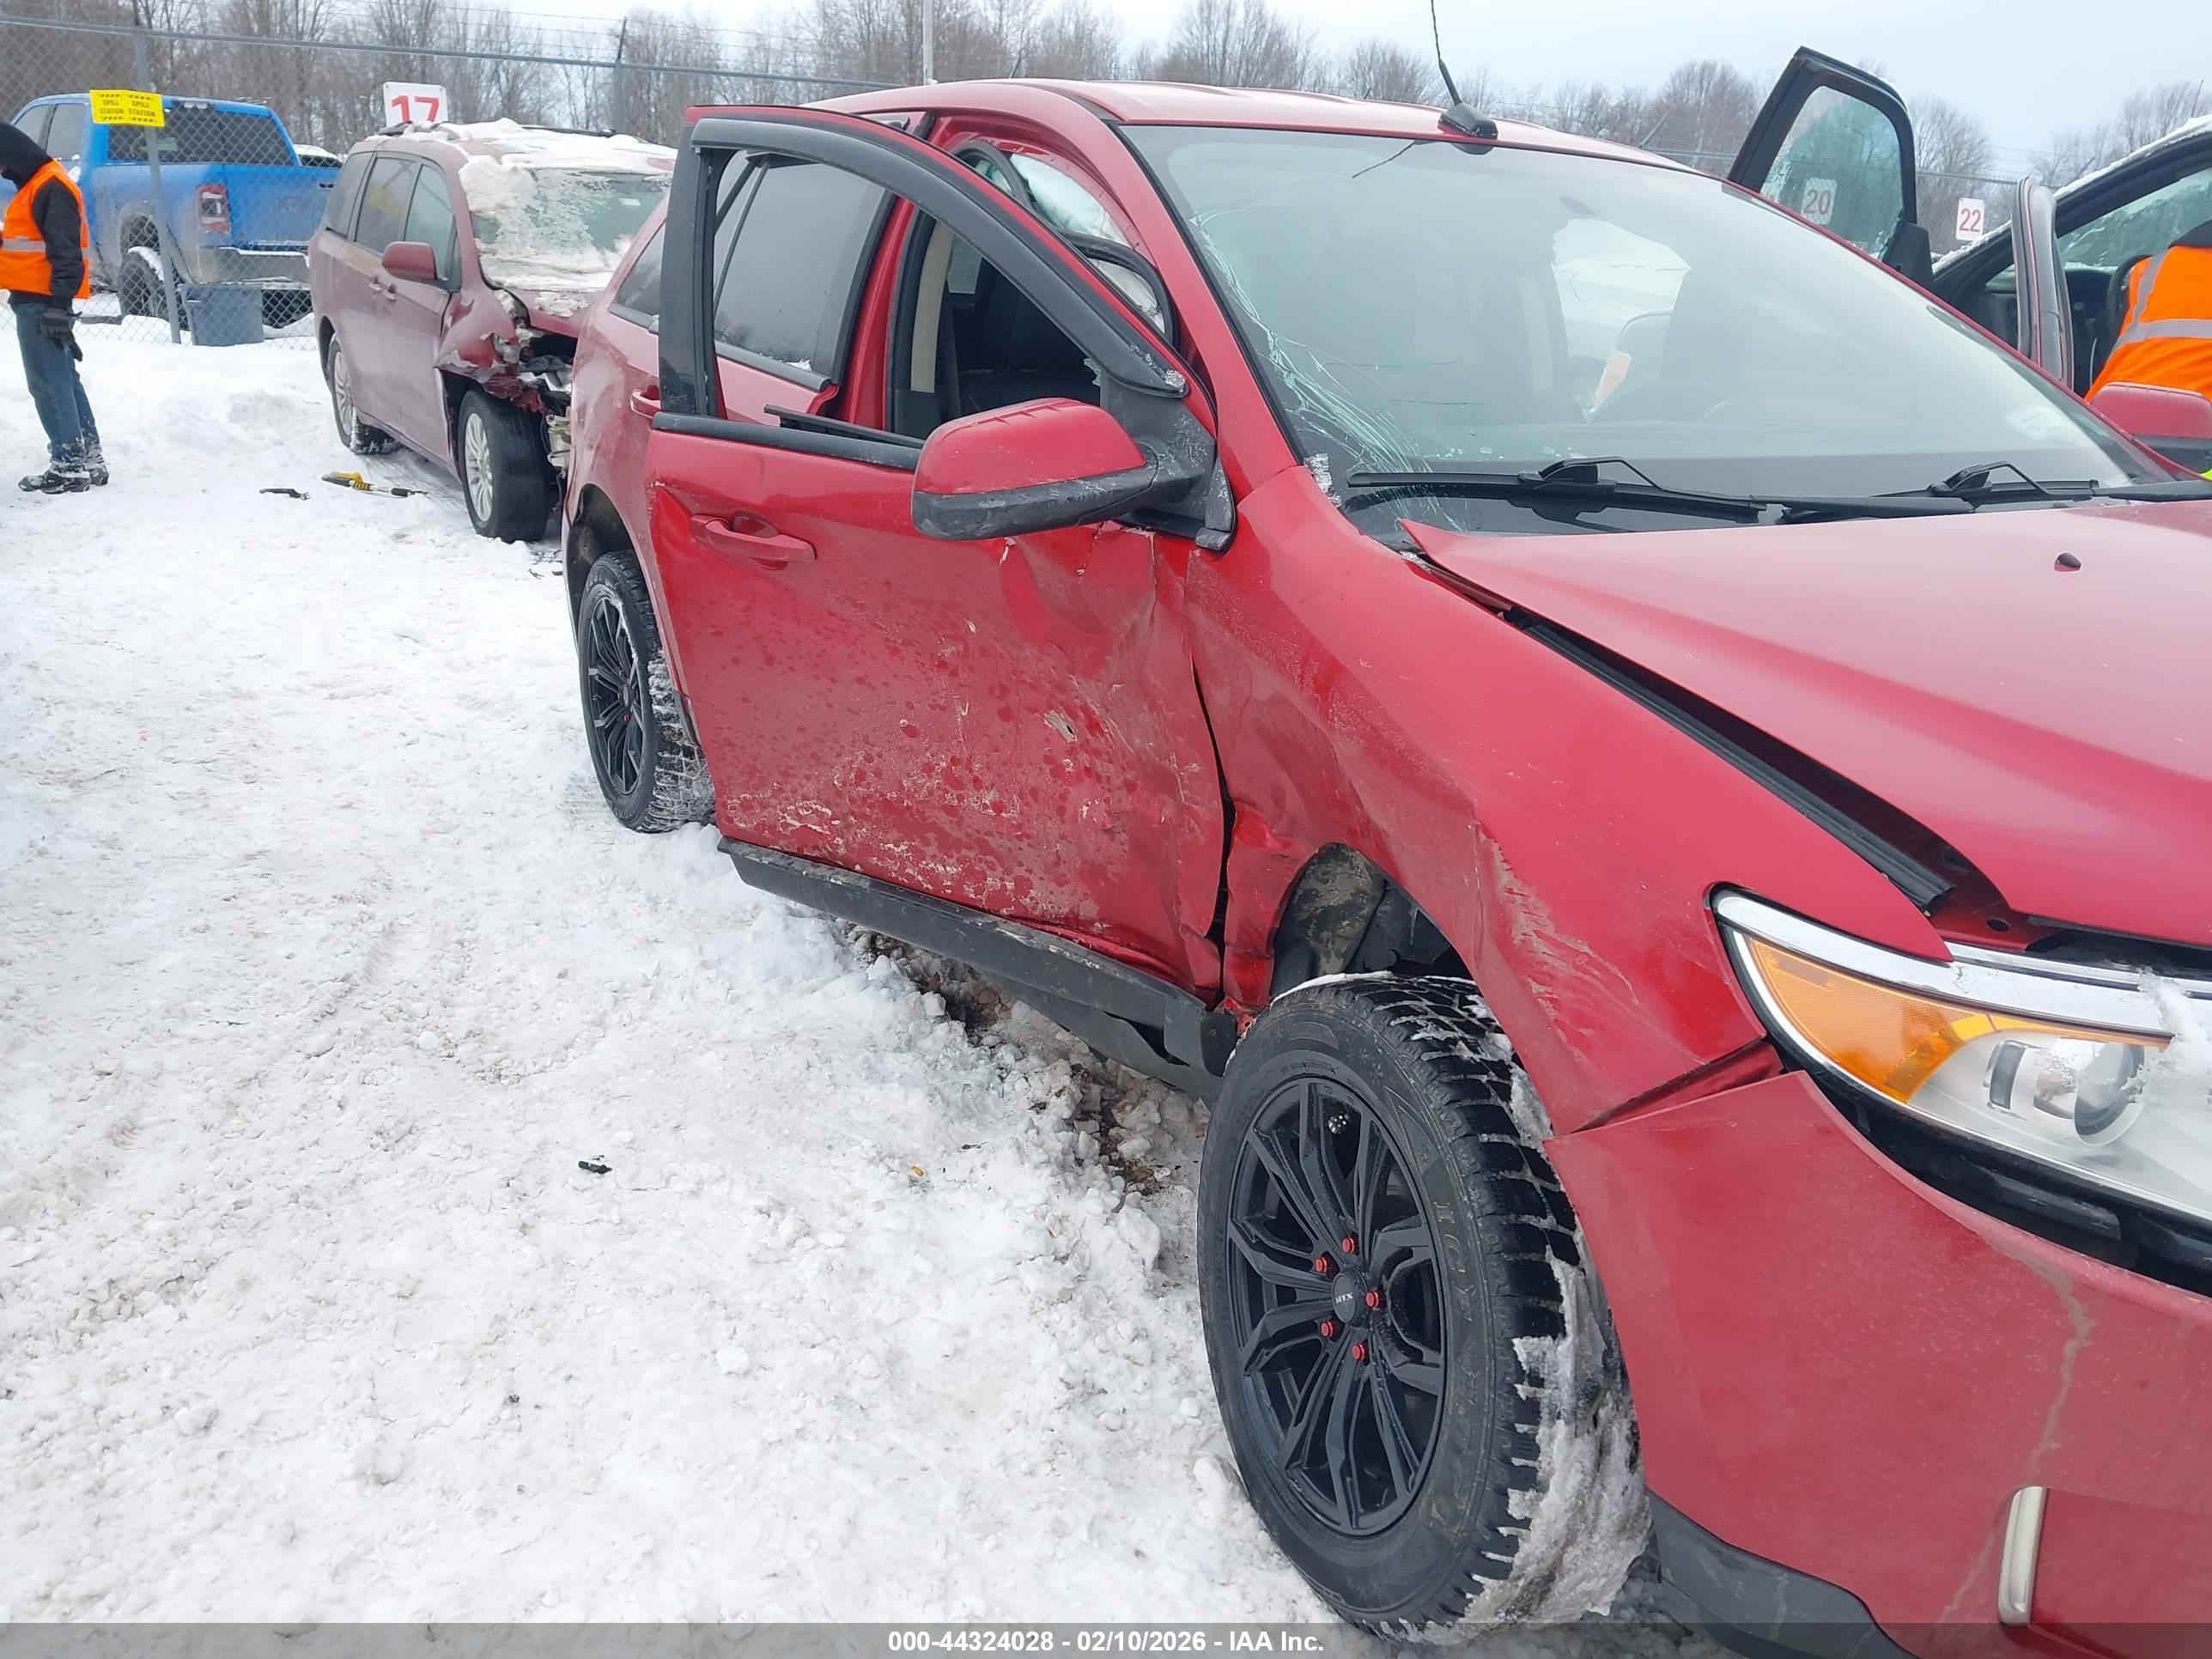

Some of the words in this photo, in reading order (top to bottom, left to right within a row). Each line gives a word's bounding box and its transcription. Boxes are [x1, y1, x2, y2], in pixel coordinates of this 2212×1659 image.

[392, 95, 440, 125] 17
[1803, 189, 1832, 215] 20
[1958, 208, 1982, 233] 22
